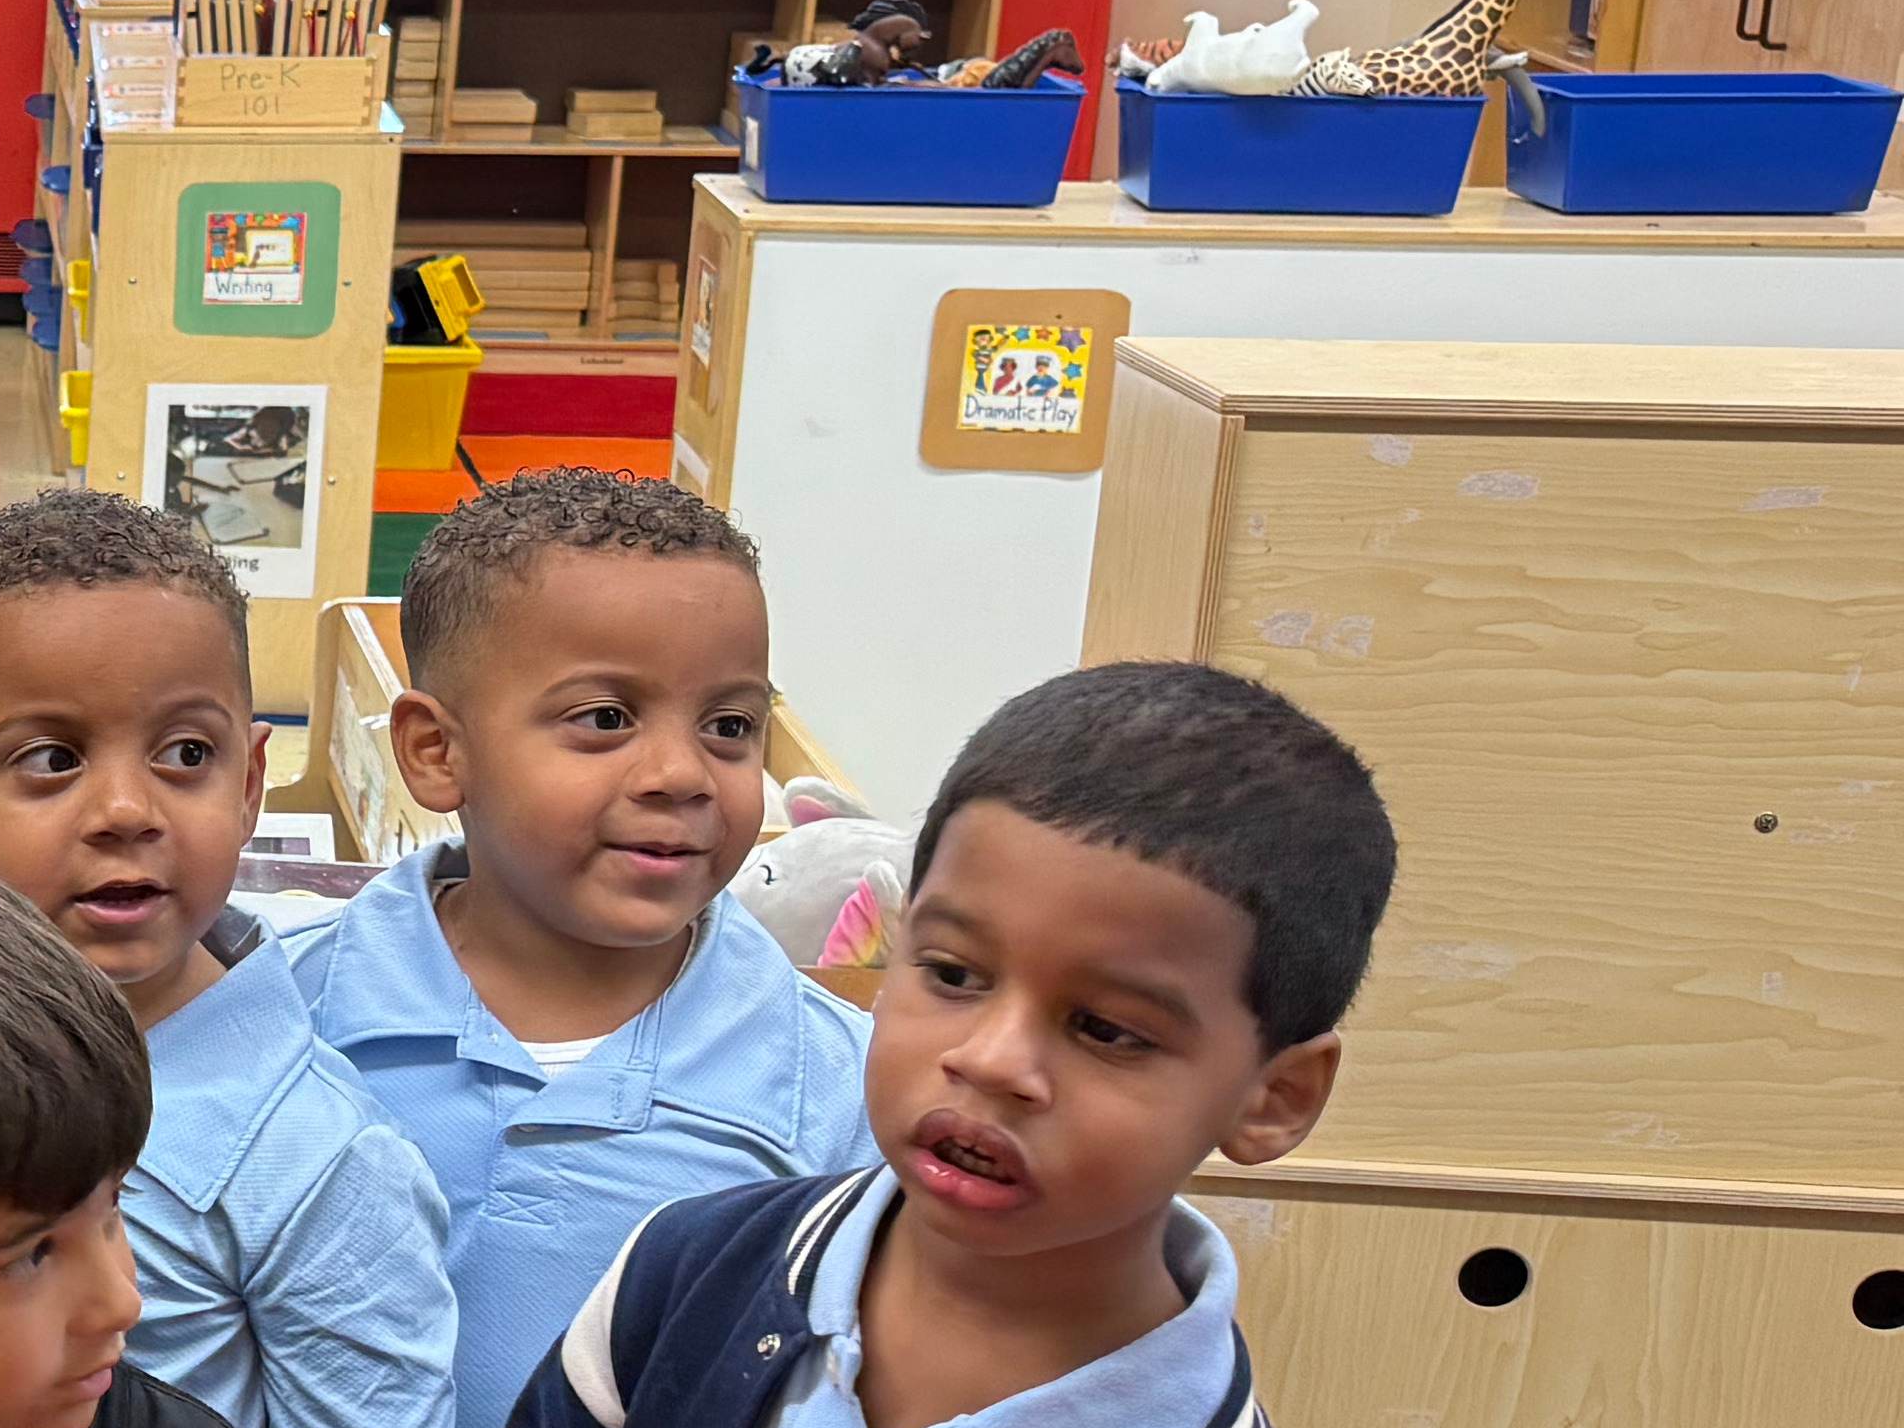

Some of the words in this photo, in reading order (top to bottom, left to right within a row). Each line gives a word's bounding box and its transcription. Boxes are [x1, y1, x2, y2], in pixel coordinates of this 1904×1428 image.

[220, 62, 302, 90] Pre-K
[242, 94, 280, 117] 101
[214, 276, 274, 302] Writing
[964, 393, 1037, 421] Dramatic
[1042, 395, 1078, 428] Play
